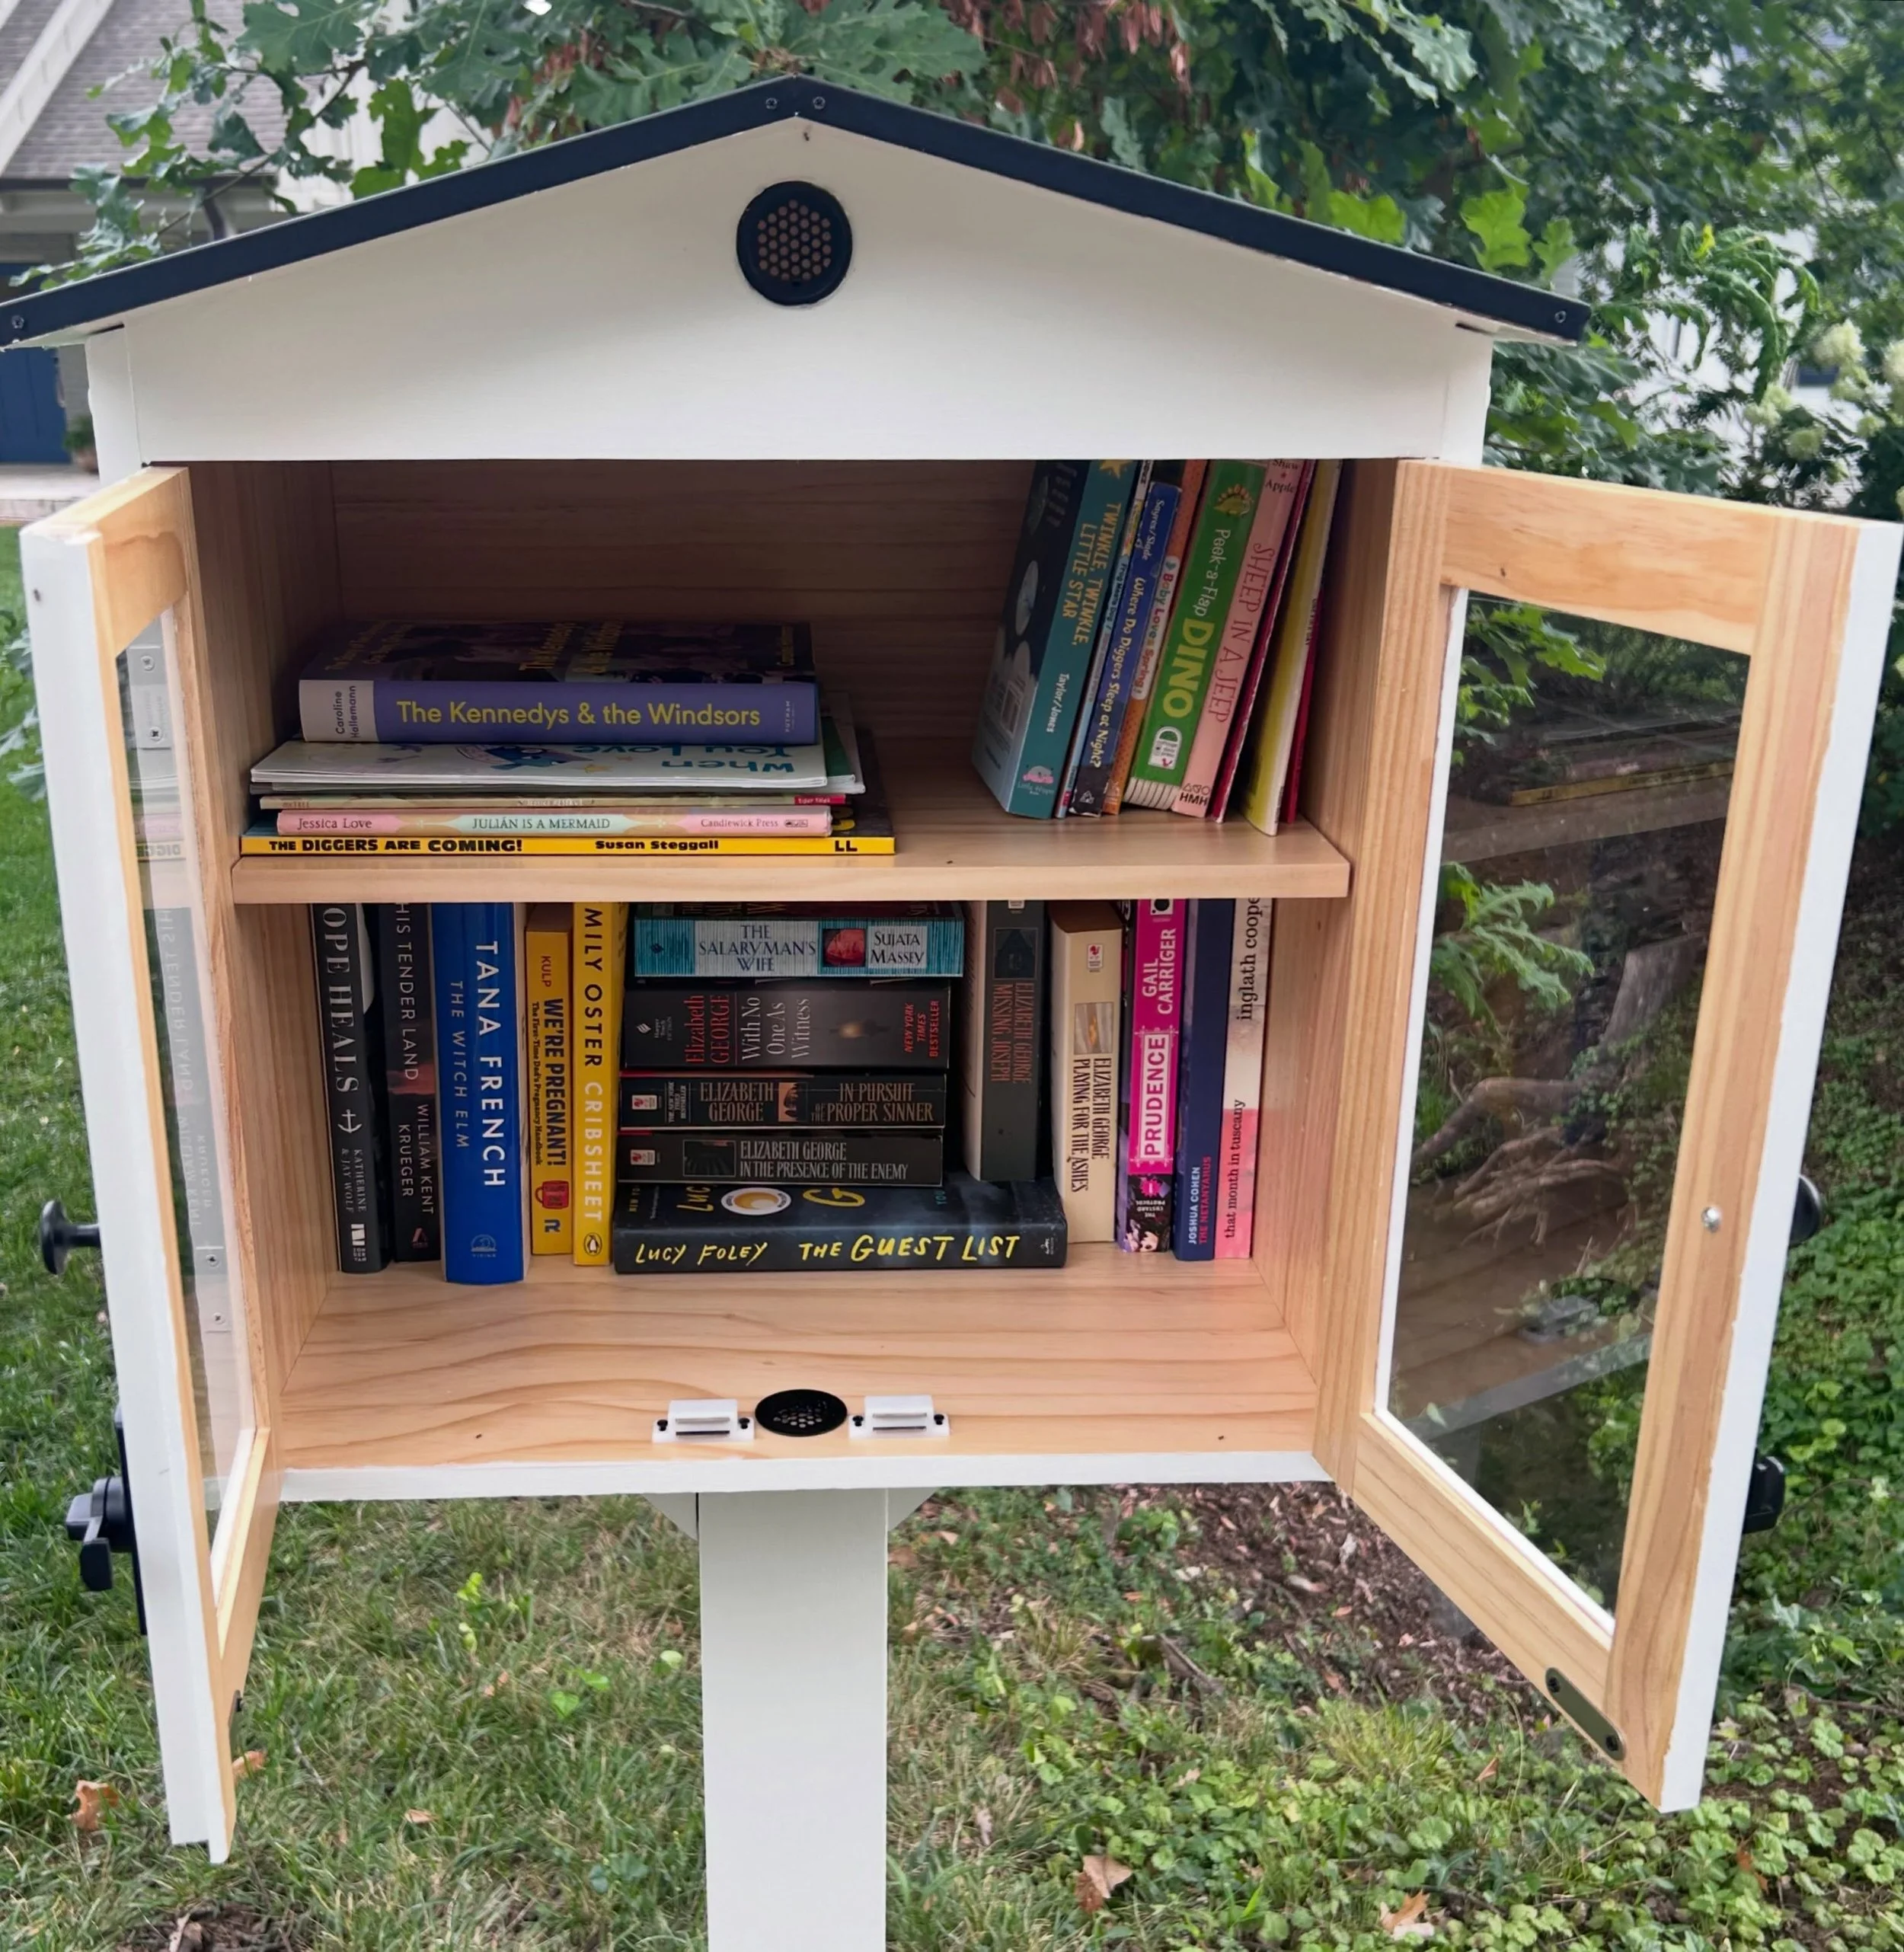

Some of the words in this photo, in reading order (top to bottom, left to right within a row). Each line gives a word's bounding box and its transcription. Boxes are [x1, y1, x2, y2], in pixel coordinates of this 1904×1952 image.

[1265, 480, 1295, 494] Apple
[1072, 523, 1097, 577] LITTLE
[1090, 503, 1121, 570] TWINKLE,
[1155, 573, 1174, 604] Baby
[1193, 529, 1232, 617] Peek-a-Flap
[1239, 543, 1275, 612] SHEEP
[1062, 580, 1084, 618] STAR
[1072, 579, 1103, 645] TWINKLE,
[1127, 577, 1145, 615] Where
[1123, 618, 1136, 634] Do
[1231, 620, 1253, 642] IN
[1111, 637, 1132, 679] Diggers
[1163, 618, 1216, 718] DINO
[1219, 647, 1244, 663] A
[336, 691, 345, 734] Caroline
[350, 685, 359, 738] Hallemann
[1046, 673, 1070, 733] Taylor/Jones
[1101, 682, 1120, 712] Sleep
[1209, 669, 1239, 723] JEEP
[397, 701, 442, 723] The
[450, 701, 570, 730] Kennedys
[577, 701, 596, 724] &
[602, 702, 642, 724] the
[647, 702, 760, 725] Windsors
[1099, 714, 1111, 727] at
[1090, 730, 1109, 768] Night?
[1180, 792, 1208, 806] HMH
[297, 818, 337, 830] Jessica
[343, 818, 372, 829] Love
[471, 816, 519, 829] JULIÁN
[522, 819, 532, 829] IS
[536, 818, 546, 829] A
[548, 817, 610, 829] MERMAID
[701, 819, 754, 828] Candlewick
[756, 819, 778, 827] Press
[269, 841, 296, 851] THE
[302, 839, 378, 851] DIGGERS
[385, 840, 421, 851] ARE
[428, 839, 522, 852] COMING!
[595, 841, 645, 850] Susan
[650, 840, 718, 851] Steggall
[835, 841, 858, 851] LL
[698, 941, 817, 955] SALARYMAN'S
[740, 925, 772, 938] THE
[874, 931, 920, 947] SUJATA
[541, 956, 552, 988] KULP
[736, 957, 775, 972] WIFE
[871, 950, 925, 965] MASSEY
[1158, 928, 1177, 1014] CARRIGER
[398, 942, 416, 1020] TENDER
[476, 941, 502, 1037] TANA
[1142, 958, 1159, 997] GAIL
[1236, 954, 1258, 1020] inglath
[451, 981, 465, 1018] THE
[532, 1002, 540, 1017] The
[742, 997, 761, 1018] No
[766, 1002, 785, 1021] As
[904, 1002, 914, 1028] YORK
[992, 984, 1013, 1034] MISSING
[1014, 982, 1034, 1039] ELIZABETH
[329, 986, 359, 1093] HEALS
[544, 998, 565, 1058] WE'RE
[584, 984, 603, 1066] OSTER
[684, 995, 704, 1062] Elizabeth
[711, 994, 730, 1064] GEORGE
[741, 1022, 761, 1060] With
[766, 1026, 785, 1055] One
[791, 998, 810, 1059] Witness
[904, 1030, 914, 1053] NEW
[917, 1012, 927, 1042] TIMES
[929, 1000, 940, 1058] BESTSELLER
[402, 1028, 419, 1080] LAND
[452, 1030, 468, 1097] WITCH
[533, 1061, 541, 1082] Dad's
[991, 1038, 1011, 1081] JOSEPH
[1013, 1043, 1033, 1084] GEORGE
[700, 1082, 774, 1101] ELIZABETH
[840, 1083, 854, 1102] IN
[859, 1083, 915, 1103] PURSUIT
[1072, 1059, 1091, 1104] PLAYING
[1092, 1057, 1112, 1114] ELIZABETH
[1144, 1037, 1165, 1156] PRUDENCE
[480, 1056, 506, 1186] FRENCH
[533, 1083, 542, 1125] Pregnancy
[545, 1063, 567, 1166] PREGNANT!
[708, 1102, 764, 1122] GEORGE
[827, 1103, 879, 1122] PROPER
[883, 1103, 934, 1122] SINNER
[1072, 1107, 1090, 1130] FOR
[417, 1104, 433, 1170] WILLIAM
[455, 1110, 469, 1148] ELM
[1072, 1133, 1089, 1155] THE
[1091, 1117, 1110, 1159] GEORGE
[1232, 1099, 1246, 1151] tuscany
[341, 1158, 352, 1178] JAY
[398, 1124, 414, 1197] KRUEGER
[584, 1081, 603, 1221] CRIBSHEET
[740, 1141, 799, 1160] ELIZABETH
[803, 1142, 847, 1161] GEORGE
[1228, 1155, 1241, 1170] in
[353, 1149, 367, 1212] KATHERINE
[740, 1161, 752, 1177] IN
[754, 1161, 775, 1177] THE
[777, 1161, 829, 1178] PRESENCE
[832, 1162, 843, 1178] OF
[848, 1163, 868, 1179] THE
[871, 1163, 909, 1180] ENEMY
[1071, 1158, 1088, 1193] ASHES
[1190, 1167, 1201, 1203] COHEN
[1200, 1156, 1212, 1222] NETANYAHUS
[343, 1182, 354, 1213] WOLF
[420, 1176, 434, 1215] KENT
[1225, 1171, 1239, 1215] month
[1188, 1205, 1199, 1244] JOSHUA
[1199, 1225, 1208, 1244] THE
[1225, 1219, 1236, 1238] that
[635, 1243, 686, 1264] LUCY
[698, 1242, 768, 1267] FOLEY
[799, 1241, 842, 1260] THE
[851, 1235, 954, 1262] GUEST
[962, 1235, 1021, 1261] LIST
